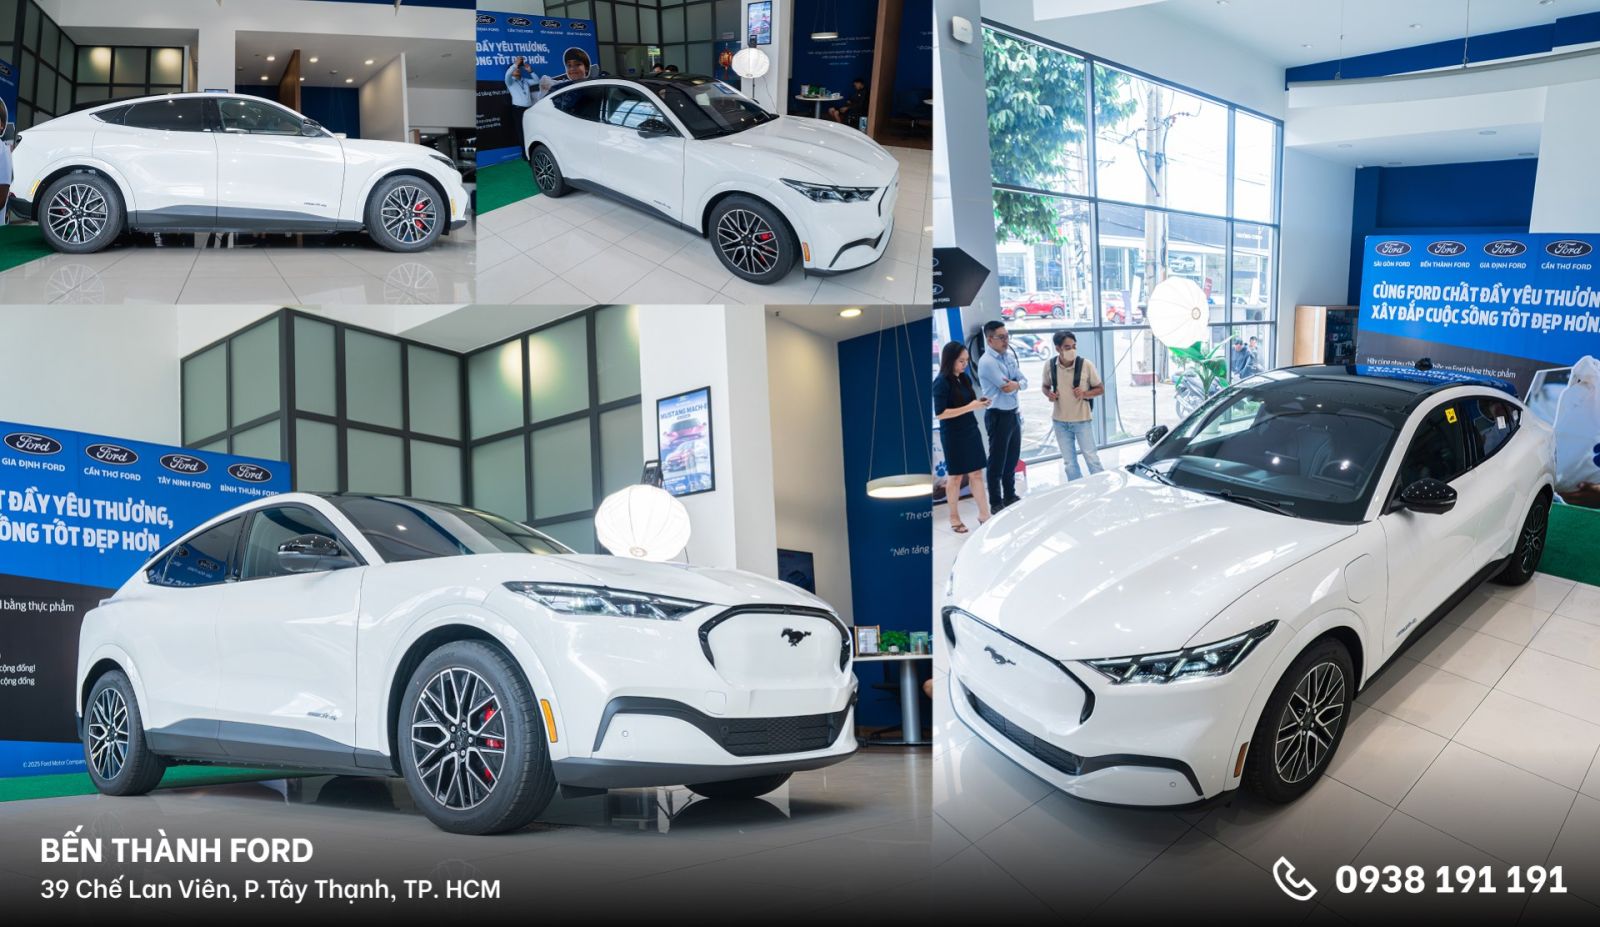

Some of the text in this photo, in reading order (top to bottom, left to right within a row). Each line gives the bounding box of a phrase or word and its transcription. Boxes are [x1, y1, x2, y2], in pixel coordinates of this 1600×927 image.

[496, 40, 514, 52] YÊU
[514, 41, 550, 54] THƯƠNG,
[1382, 242, 1404, 254] Ford
[1434, 242, 1458, 254] Ford
[1491, 241, 1518, 254] Ford
[1554, 241, 1583, 255] Ford
[1420, 260, 1432, 268] BẾN
[1433, 261, 1453, 269] THÀNH
[1491, 262, 1508, 271] ĐỊNH
[1508, 262, 1527, 270] FORD
[1557, 262, 1572, 271] THƠ
[1572, 262, 1592, 271] FORD
[1372, 281, 1406, 300] CÙNG
[1406, 284, 1442, 301] FORD
[1442, 282, 1480, 303] CHẤT
[1480, 282, 1511, 304] ĐẦY
[1513, 284, 1543, 305] YÊU
[1371, 301, 1397, 321] XÂY
[1397, 299, 1425, 322] ĐẮP
[1425, 304, 1460, 328] CUỘC
[1460, 304, 1499, 328] SỐNG
[1500, 306, 1531, 328] TỐT
[1530, 312, 1563, 334] ĐẸP
[1482, 367, 1497, 378] thực
[1497, 368, 1516, 381] phẩm
[16, 434, 51, 453] Ford
[96, 445, 128, 463] Ford
[1, 457, 66, 472] GIA ĐỊNH FORD
[169, 455, 199, 472] Ford
[101, 468, 119, 479] THƠ
[120, 471, 142, 481] FORD
[236, 463, 263, 480] Ford
[172, 479, 191, 489] NINH
[191, 481, 212, 491] FORD
[219, 484, 237, 494] BÌNH
[238, 487, 261, 498] THUẬN
[8, 486, 50, 515] ĐẦY
[52, 491, 91, 518] YÊU
[92, 497, 174, 530] THƯƠNG,
[41, 518, 81, 547] TỐT
[82, 527, 119, 554] ĐẸP
[122, 527, 160, 552] HƠN
[4, 598, 27, 612] bằng
[28, 600, 48, 613] thực
[49, 599, 74, 614] phẩm
[0, 664, 16, 674] cộng
[0, 677, 17, 686] cộng
[28, 760, 40, 768] 2025
